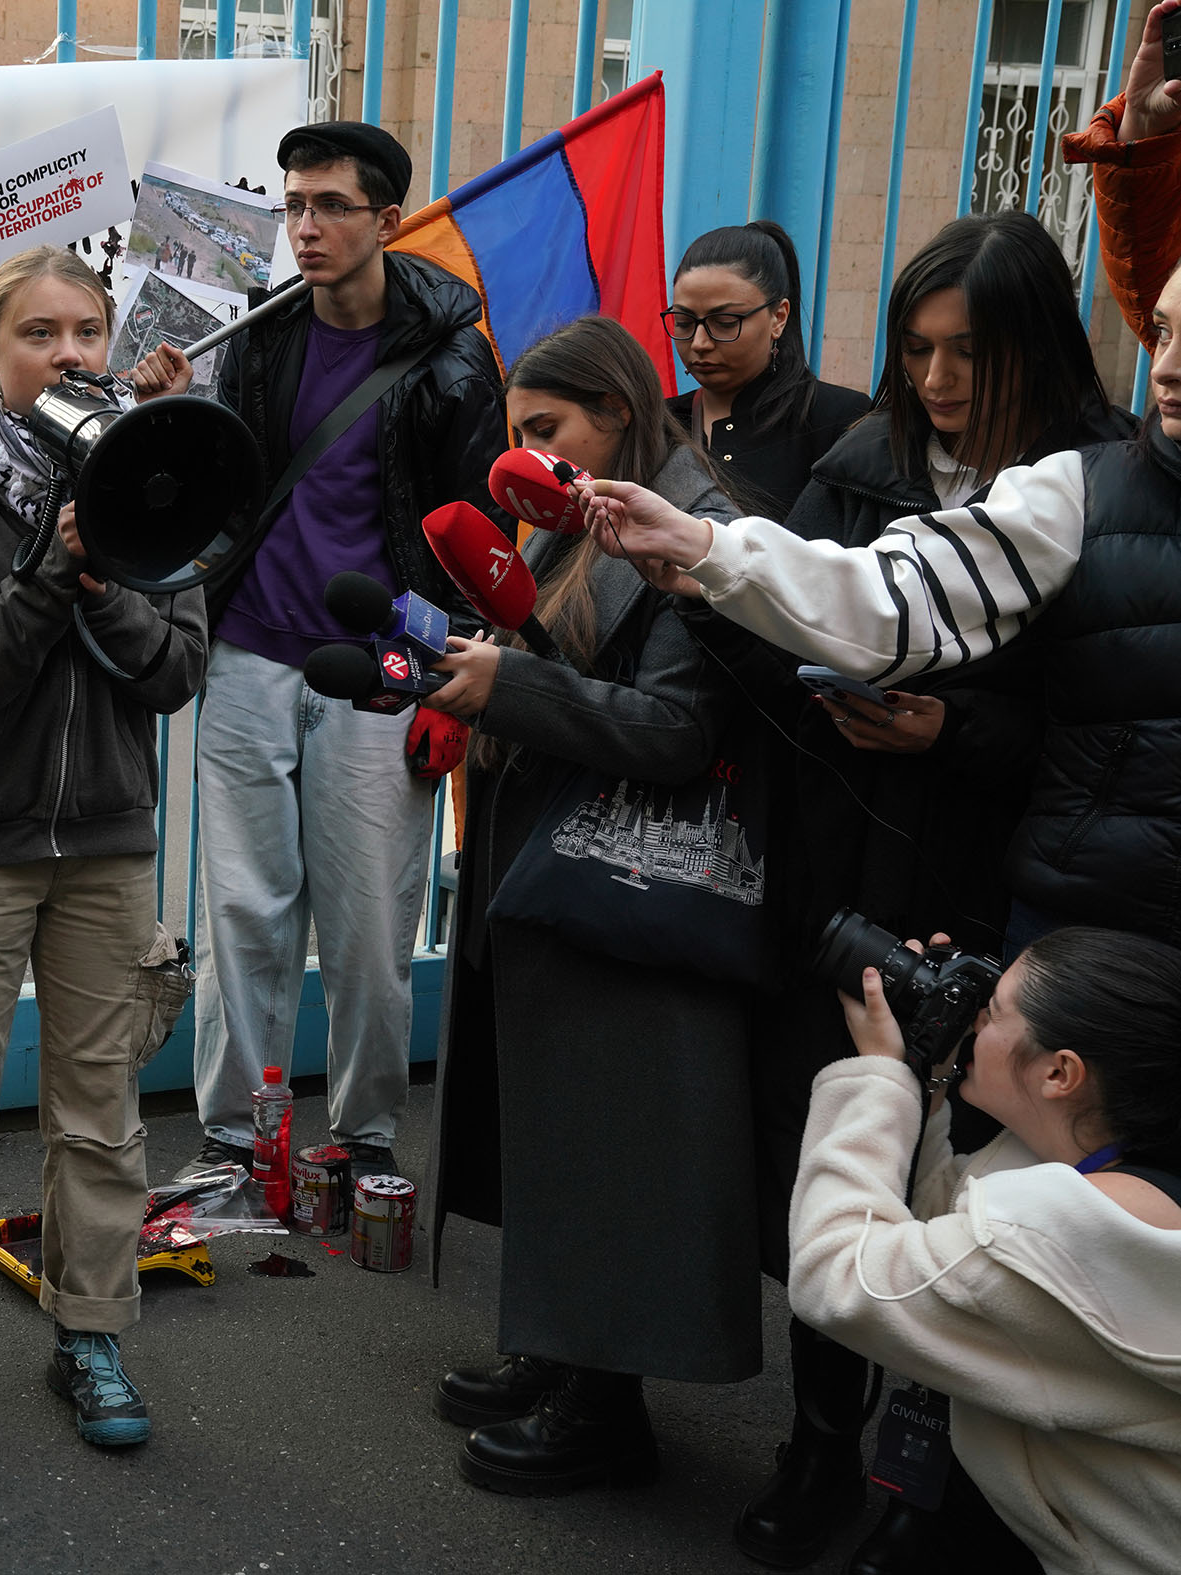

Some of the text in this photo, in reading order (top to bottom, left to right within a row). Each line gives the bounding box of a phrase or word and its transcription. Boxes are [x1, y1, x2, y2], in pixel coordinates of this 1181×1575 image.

[5, 148, 87, 193] COMPLICITY
[86, 171, 105, 189] OF
[890, 1402, 946, 1433] CIVILNET
